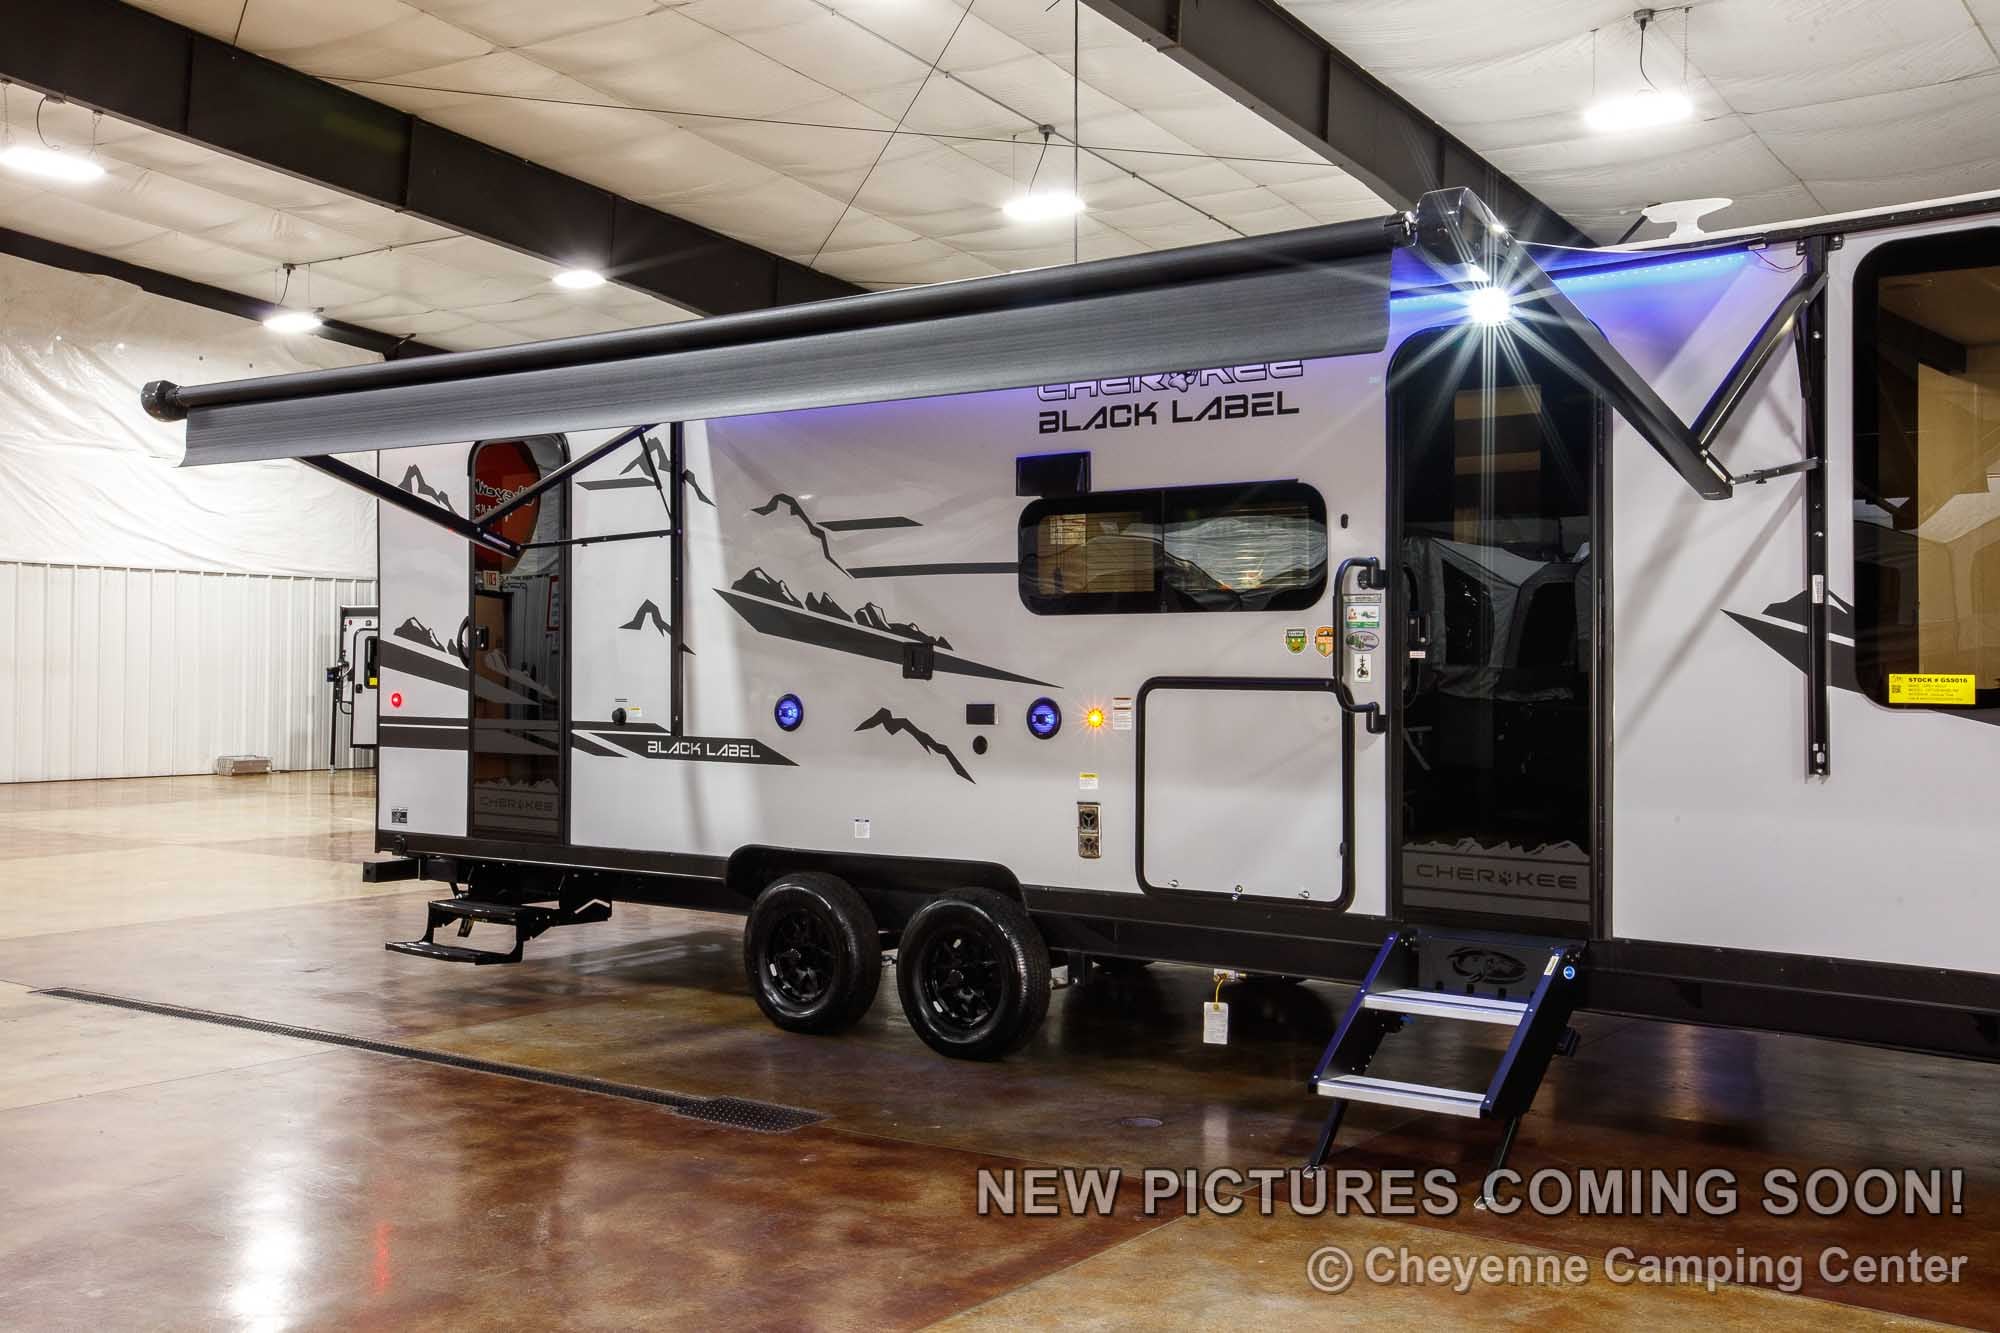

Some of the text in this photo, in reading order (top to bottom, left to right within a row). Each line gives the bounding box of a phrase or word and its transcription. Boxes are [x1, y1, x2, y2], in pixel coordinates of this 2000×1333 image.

[1038, 391, 1300, 434] BLACK LABEL
[647, 740, 761, 758] BLACK LABEL
